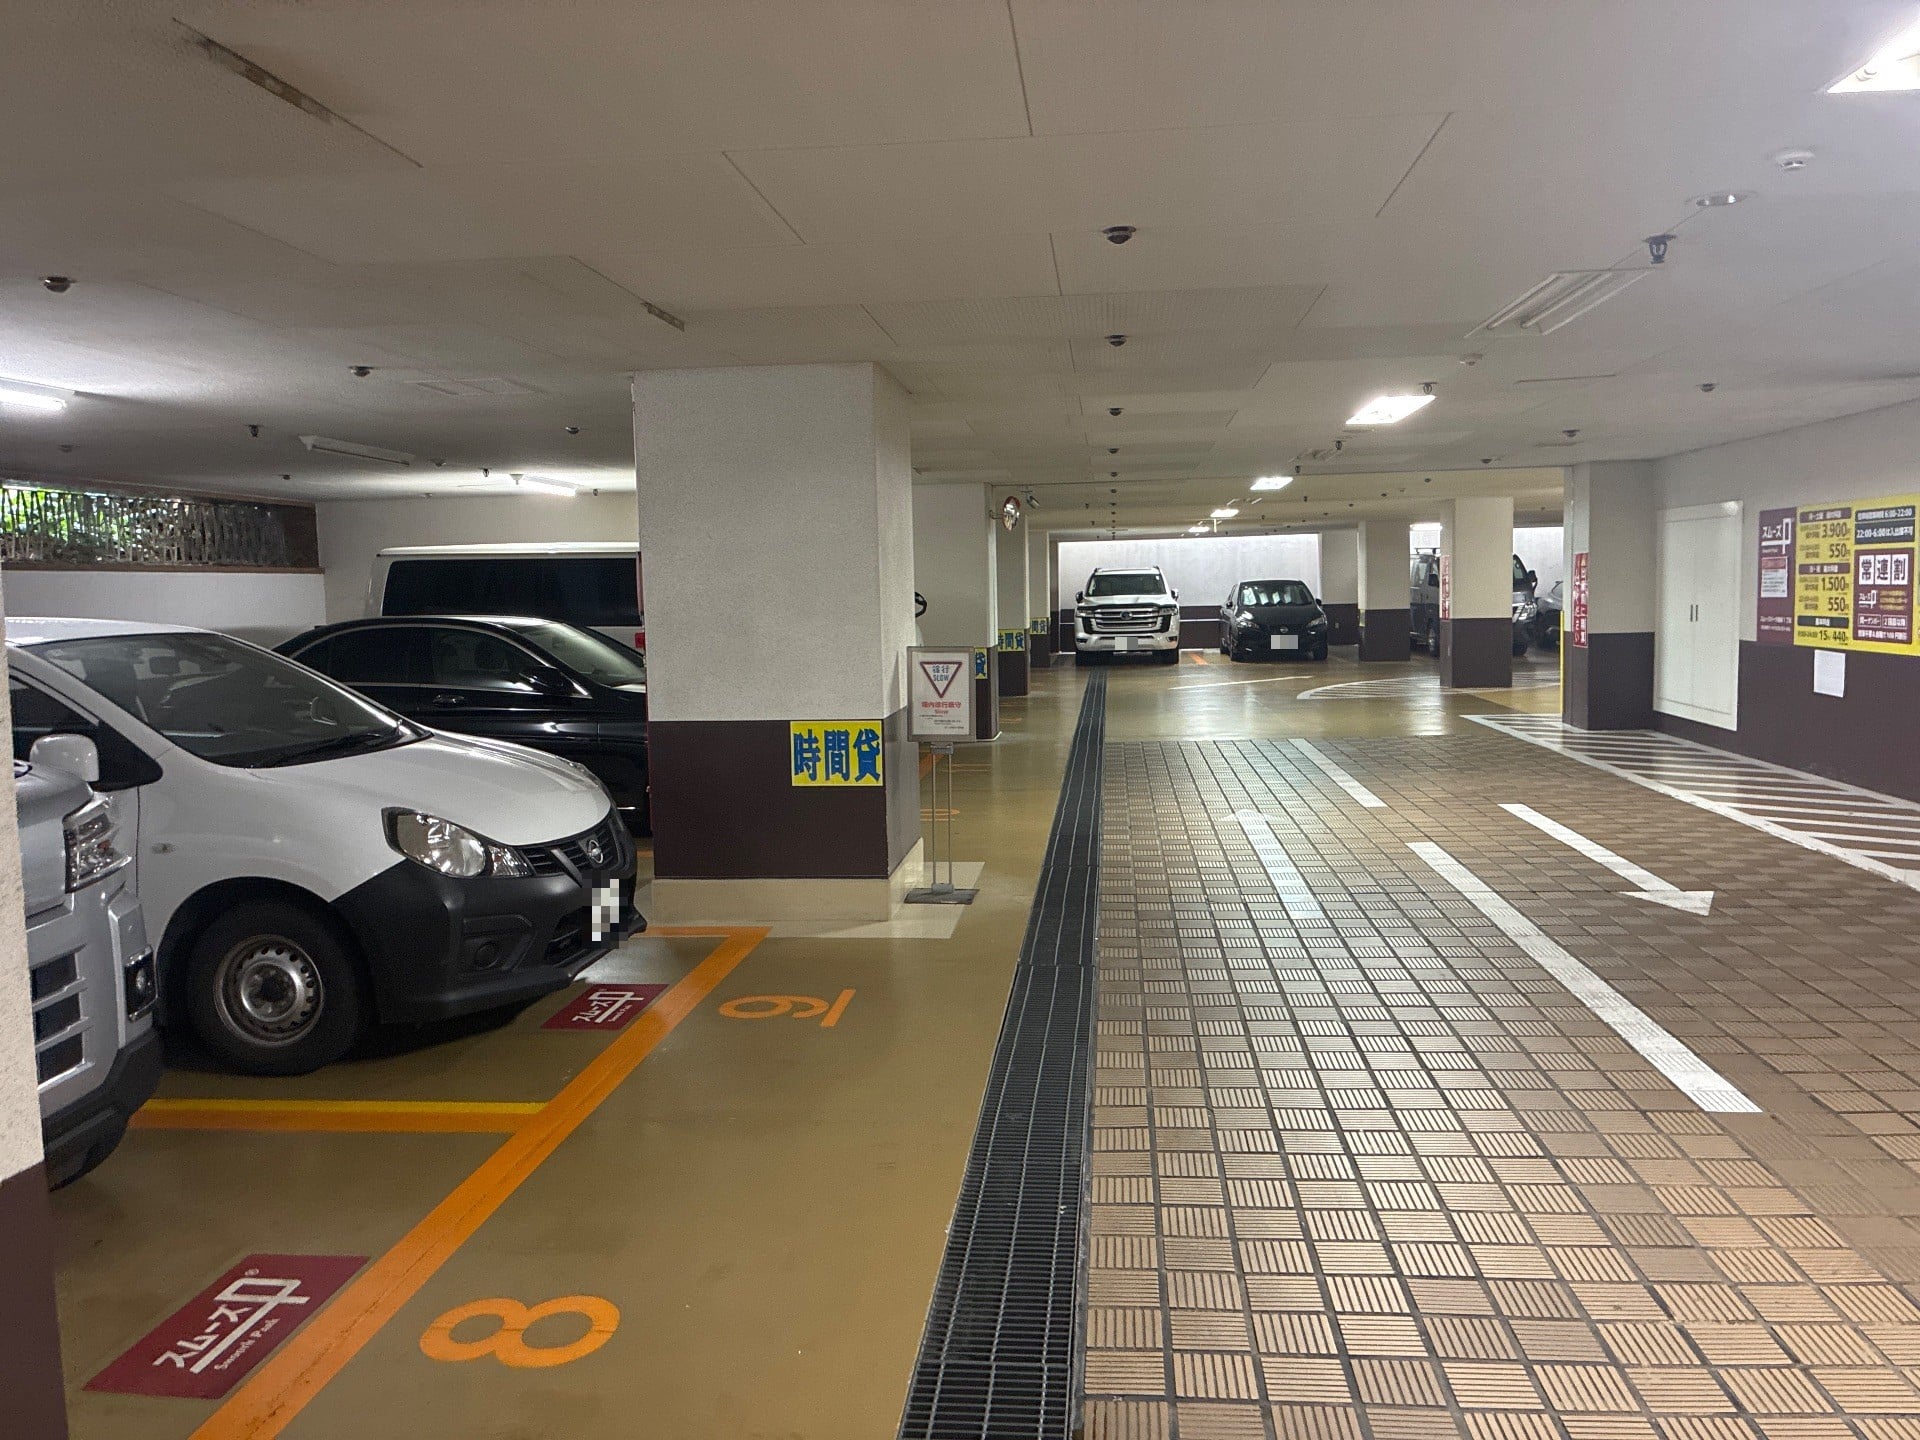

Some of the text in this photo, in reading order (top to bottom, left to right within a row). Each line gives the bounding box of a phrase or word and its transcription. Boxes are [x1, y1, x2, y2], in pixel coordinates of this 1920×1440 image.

[933, 674, 949, 682] SLOW
[793, 728, 881, 782] 時間貸
[419, 1295, 620, 1368] 8
